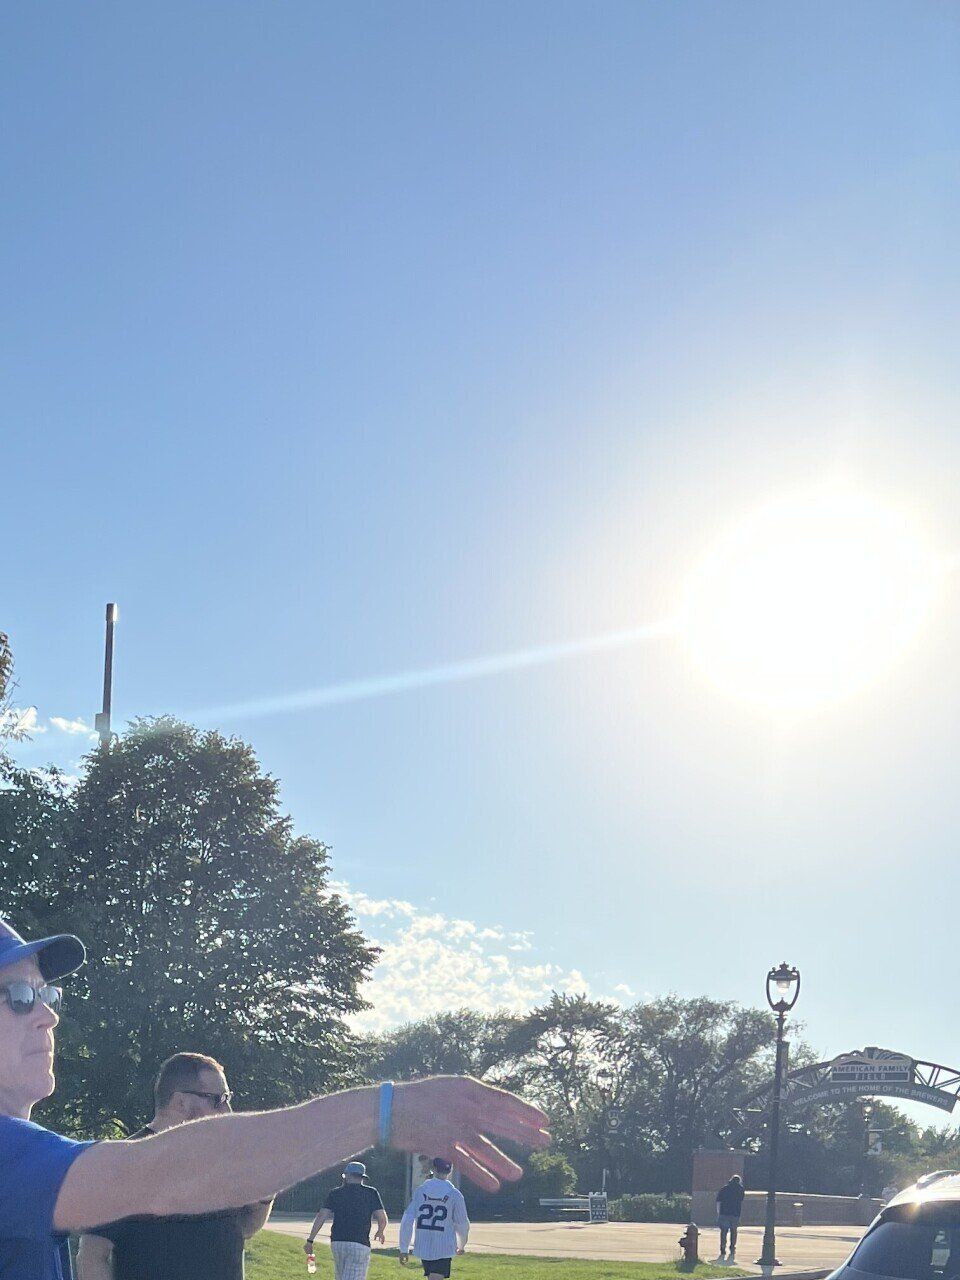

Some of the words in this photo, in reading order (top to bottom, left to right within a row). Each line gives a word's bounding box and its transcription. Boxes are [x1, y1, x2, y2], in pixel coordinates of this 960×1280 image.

[792, 1090, 829, 1106] WELCOME
[895, 1086, 910, 1095] THE
[910, 1089, 949, 1105] BREWERS
[417, 1204, 447, 1231] 22
